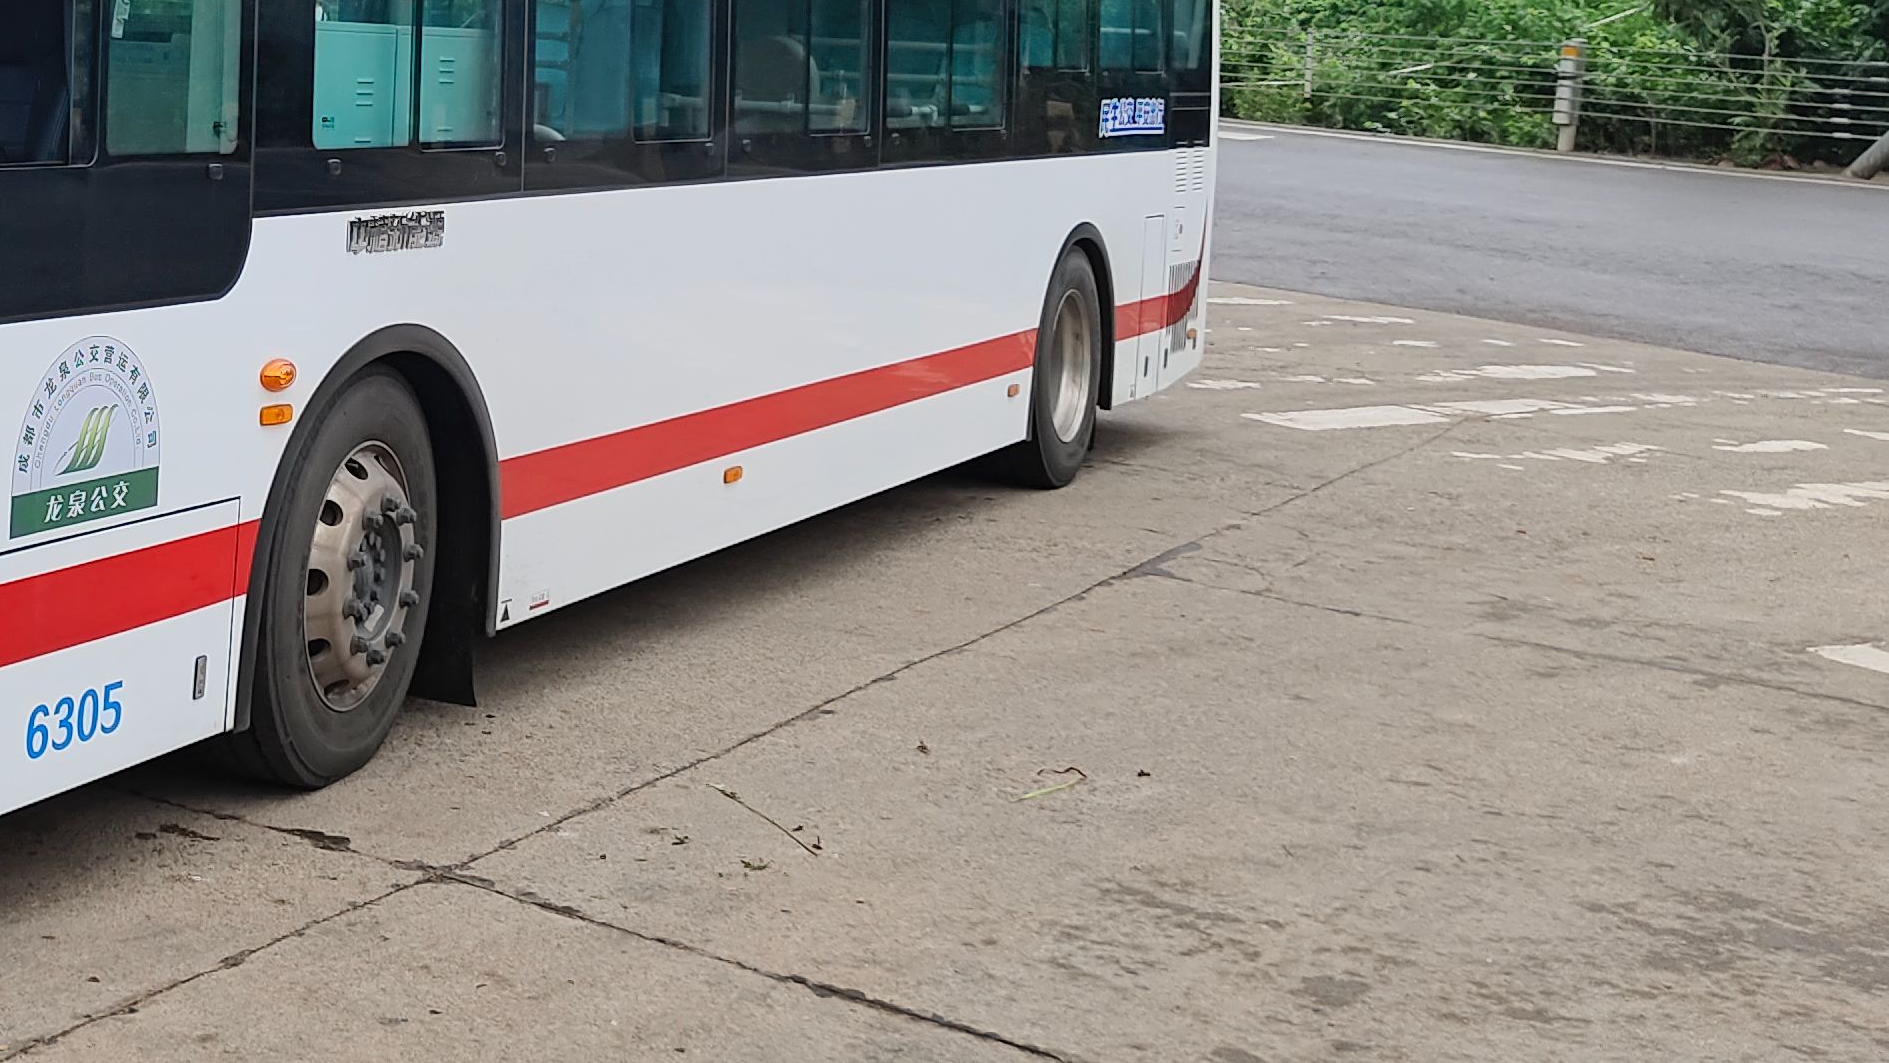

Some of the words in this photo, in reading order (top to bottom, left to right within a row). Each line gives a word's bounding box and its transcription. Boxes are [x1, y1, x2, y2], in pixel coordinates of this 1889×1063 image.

[17, 344, 157, 474] 成都市龙泉公交营运有限公司
[34, 415, 54, 469] Chengdu
[53, 376, 87, 412] Longquan
[43, 480, 131, 524] 龙泉公交
[25, 680, 124, 760] 6305
